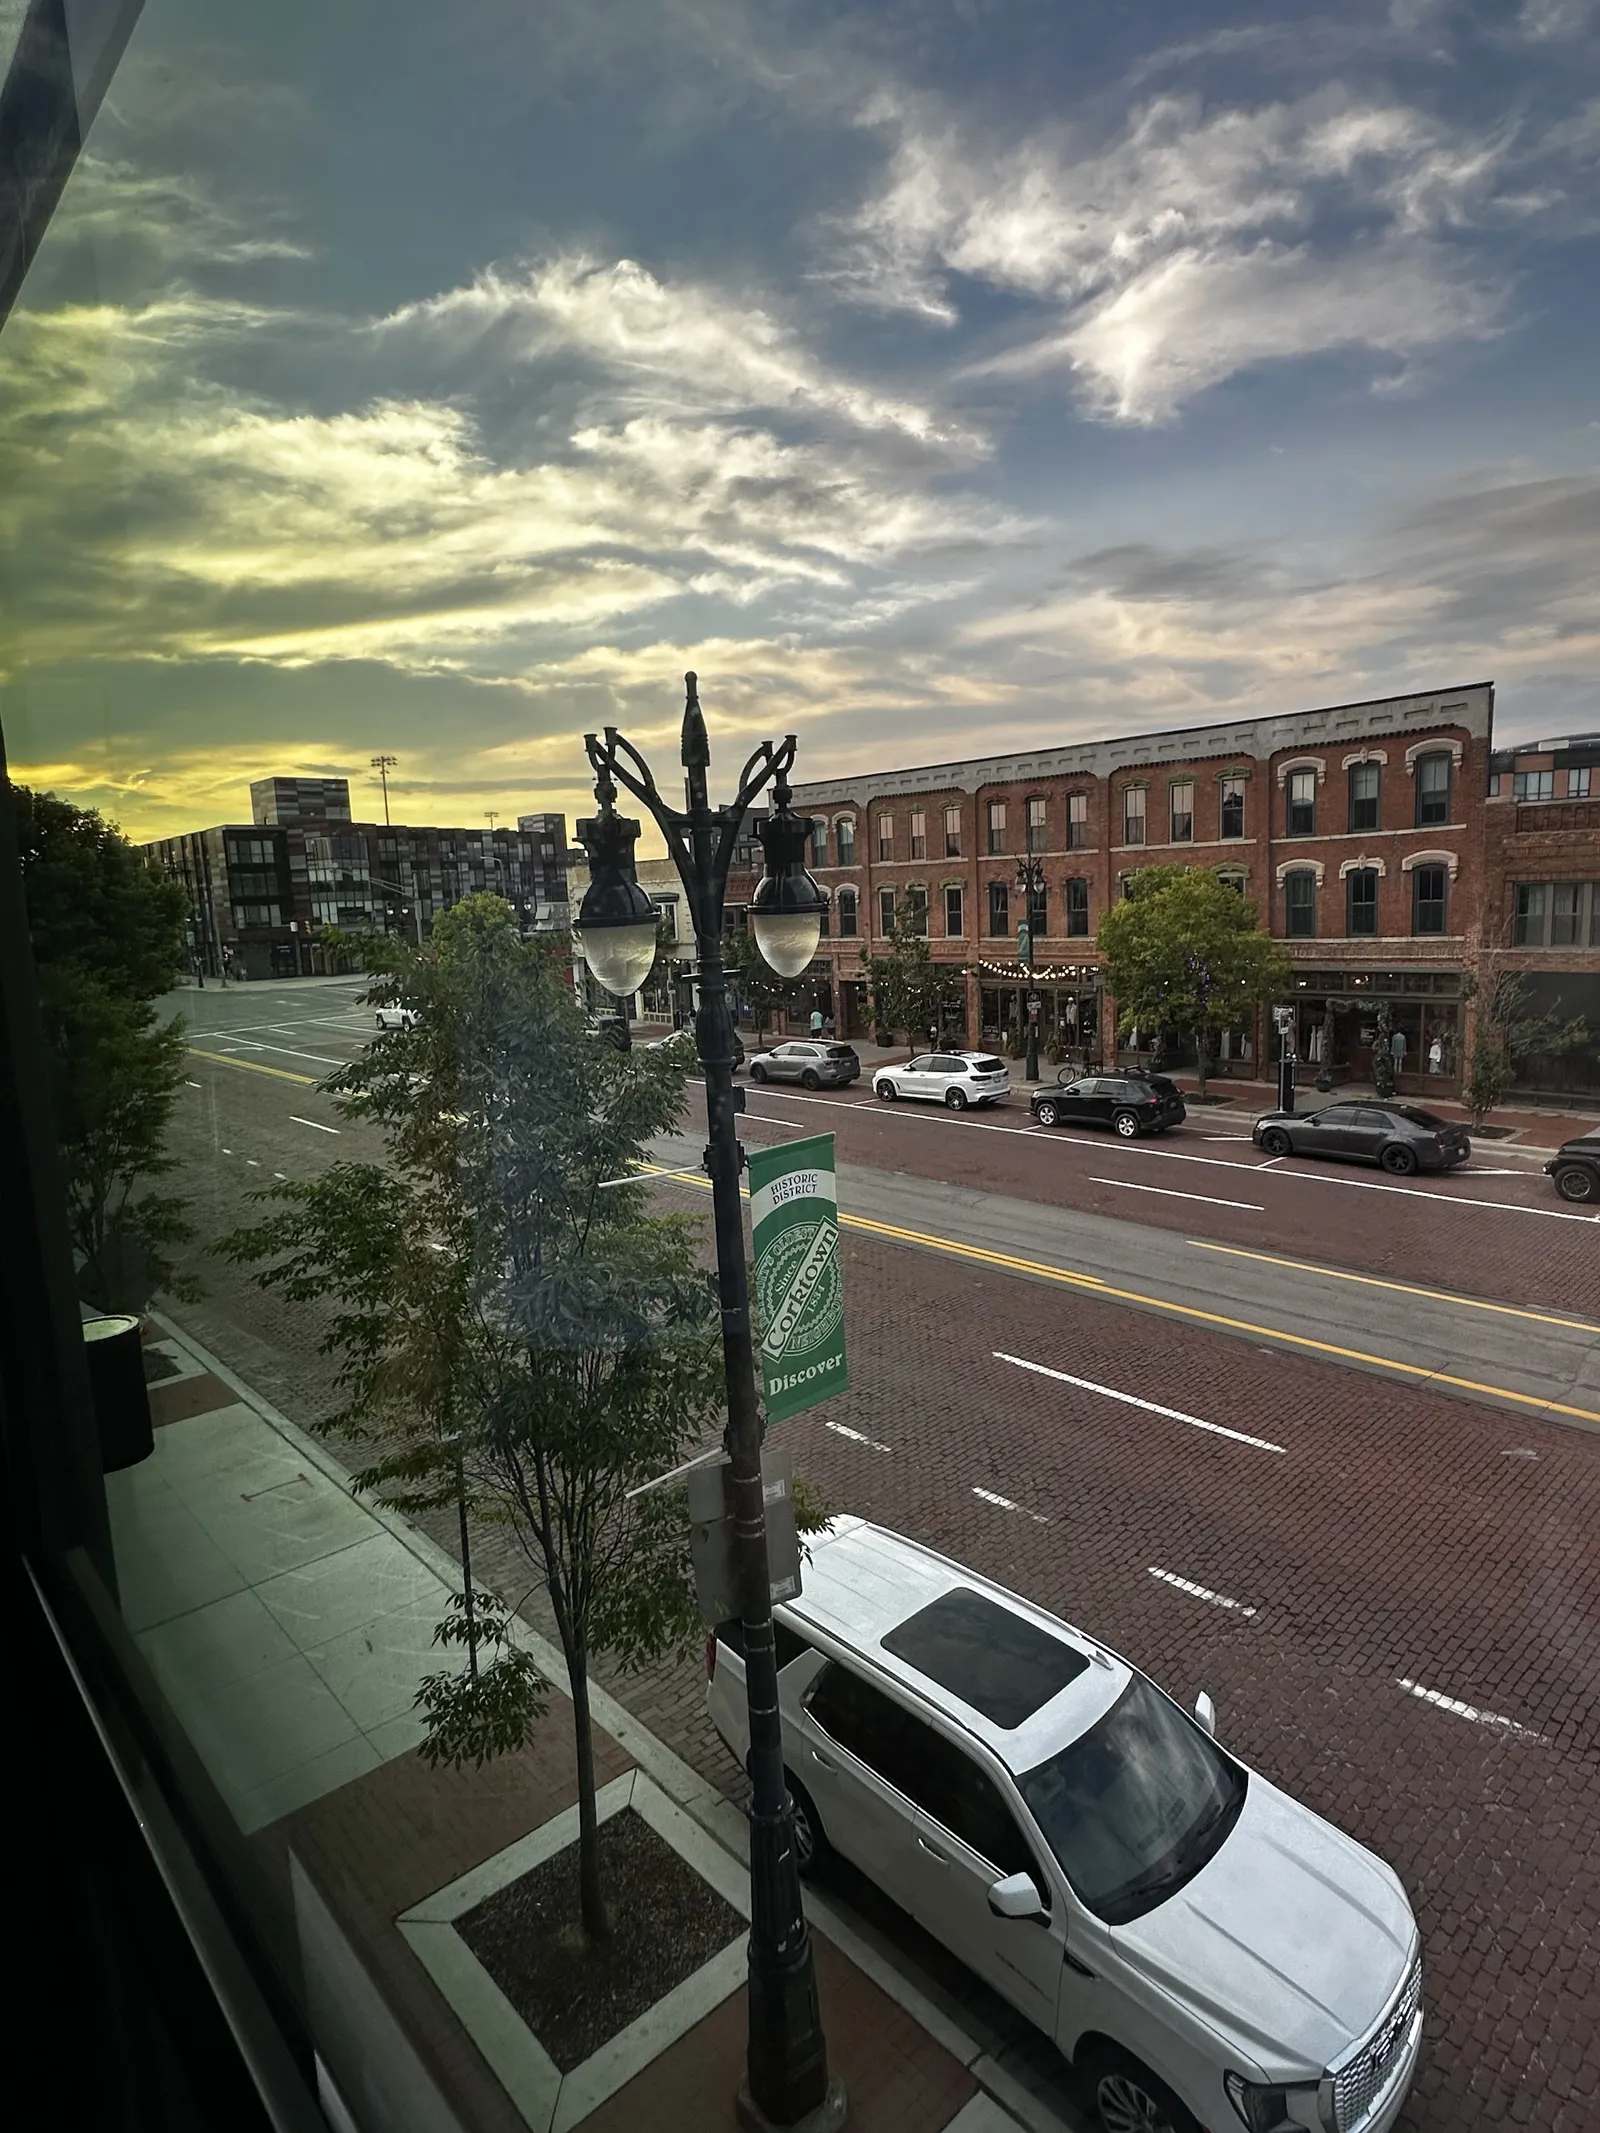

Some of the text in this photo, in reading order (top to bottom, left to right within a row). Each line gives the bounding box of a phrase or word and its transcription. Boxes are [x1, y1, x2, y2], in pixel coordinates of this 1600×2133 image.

[770, 1174, 818, 1195] HISTORIC
[772, 1184, 818, 1205] DISTRICT
[773, 1227, 815, 1256] OLDEST
[768, 1229, 837, 1350] Corktown
[775, 1261, 797, 1295] Since
[769, 1353, 843, 1396] Discover
